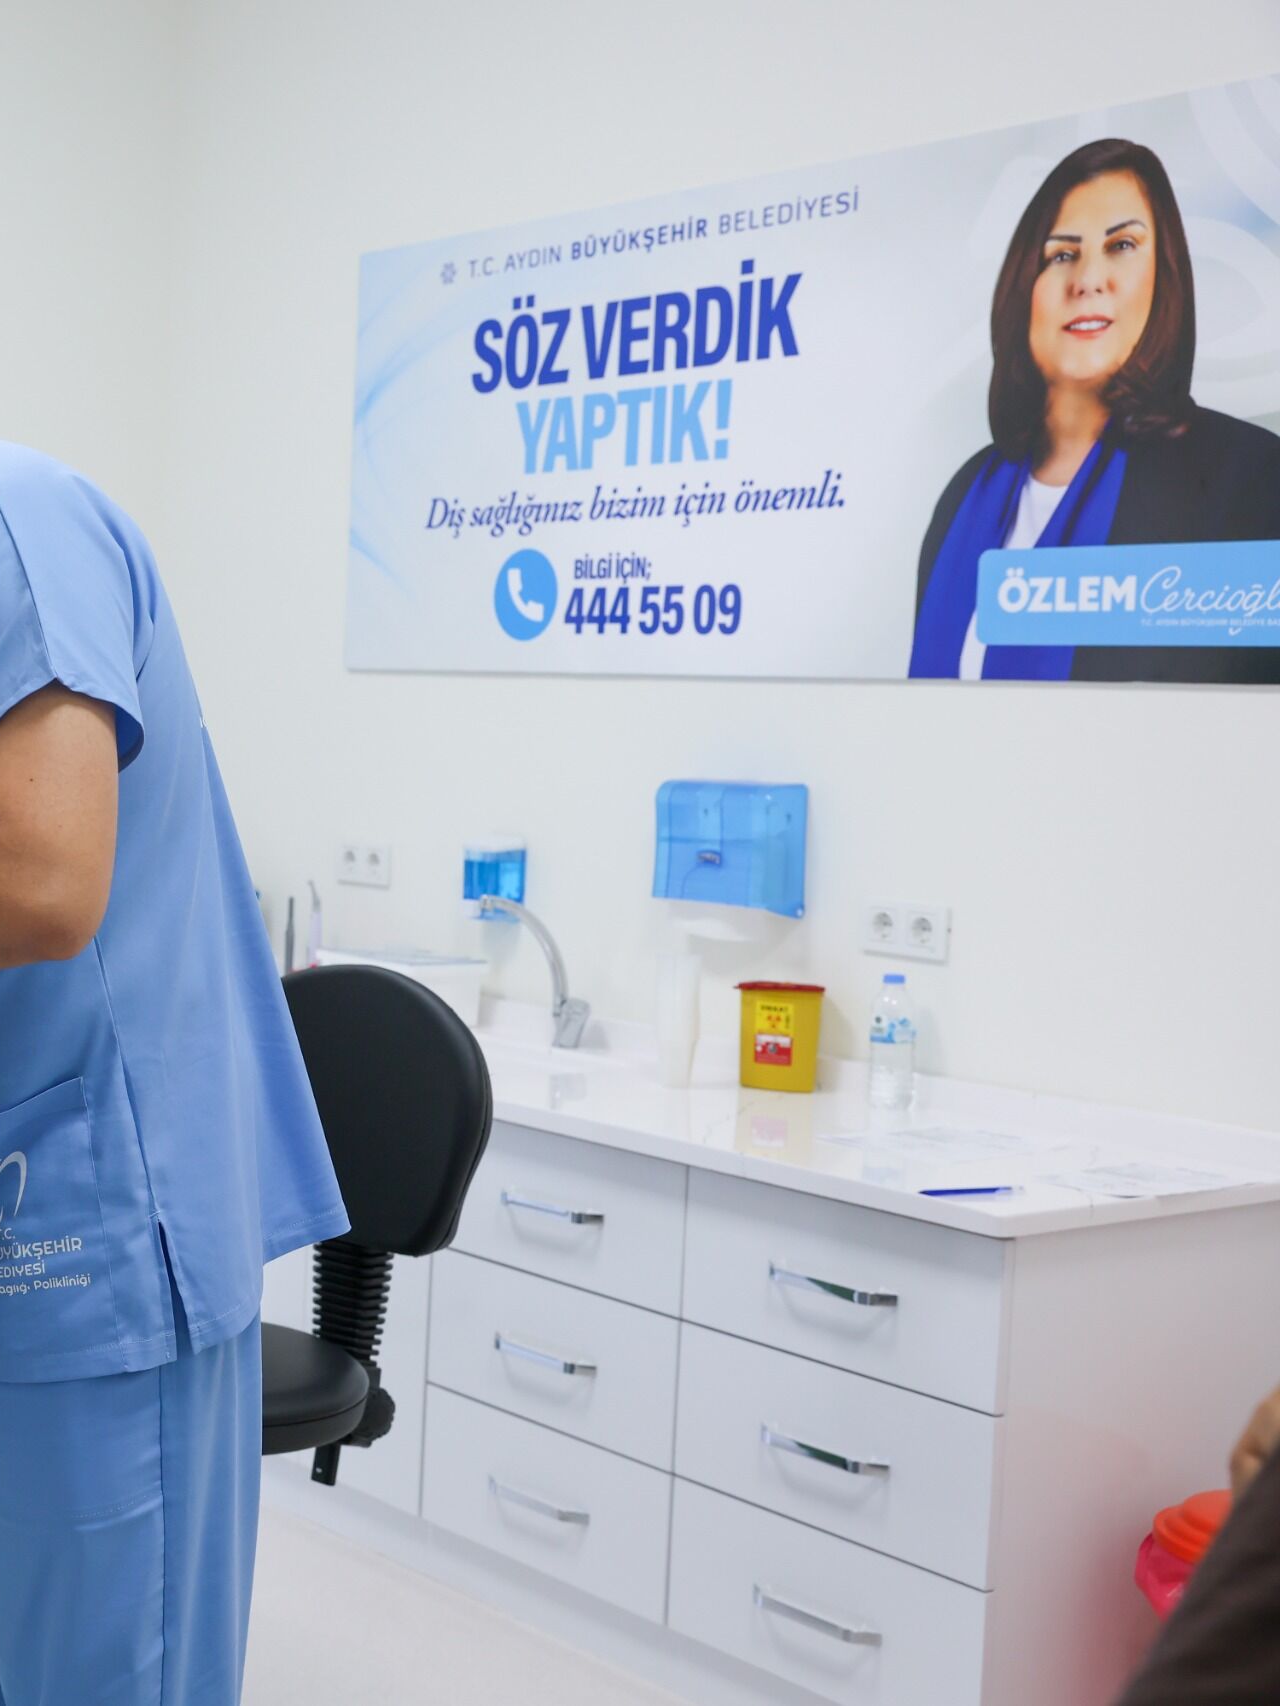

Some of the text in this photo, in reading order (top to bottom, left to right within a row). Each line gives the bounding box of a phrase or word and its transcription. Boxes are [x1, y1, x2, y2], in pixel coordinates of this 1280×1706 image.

[468, 185, 860, 278] T.C. AYDIN BÜYÜKŞEHİR BELEDİYESİ
[471, 258, 803, 394] SÖZ VERDİK
[516, 378, 732, 474] YAPTIK!
[424, 468, 844, 538] Diş sağlığınız bizim için önemli.
[573, 553, 612, 580] BİLGİ
[997, 567, 1137, 613] ÖZLEM
[564, 584, 742, 635] 444 55 09
